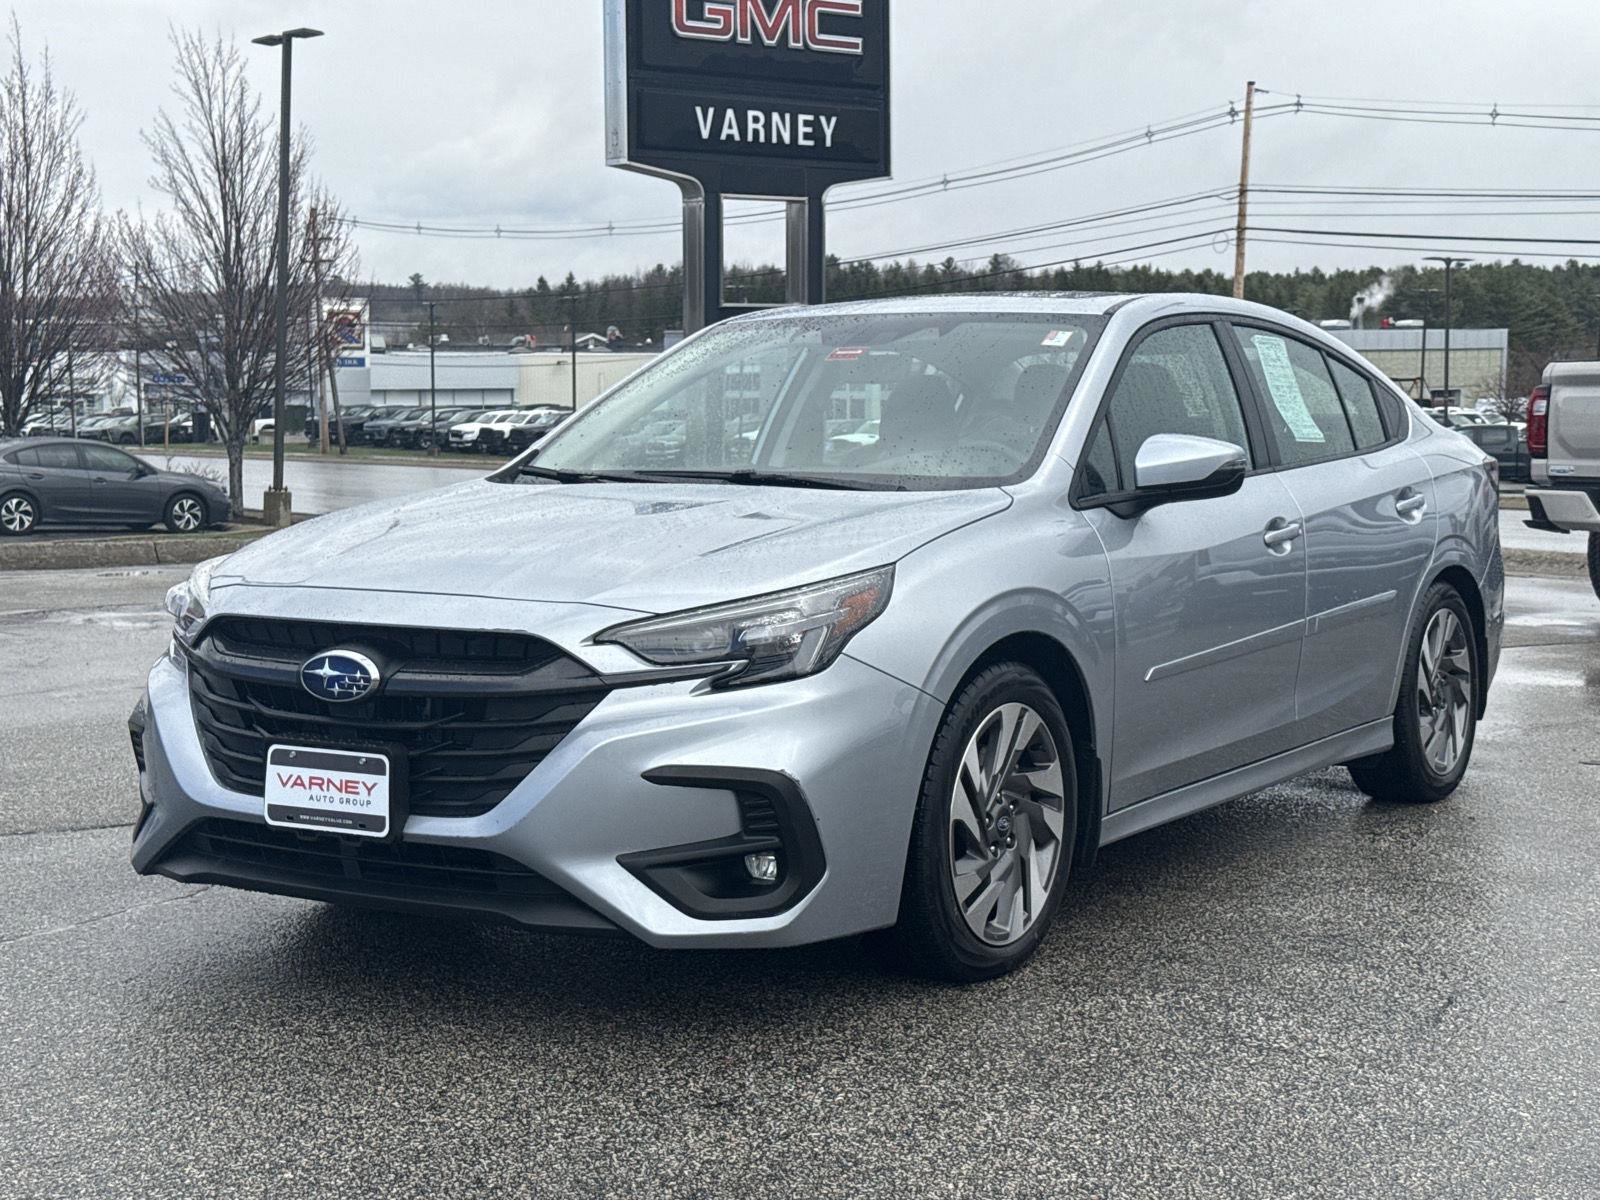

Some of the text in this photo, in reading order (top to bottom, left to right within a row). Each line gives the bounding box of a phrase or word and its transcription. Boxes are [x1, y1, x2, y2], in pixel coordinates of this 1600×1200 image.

[672, 0, 863, 54] GMC
[694, 105, 838, 148] VARNEY
[277, 772, 378, 796] VARNEY
[308, 794, 372, 808] AUTO GROUP
